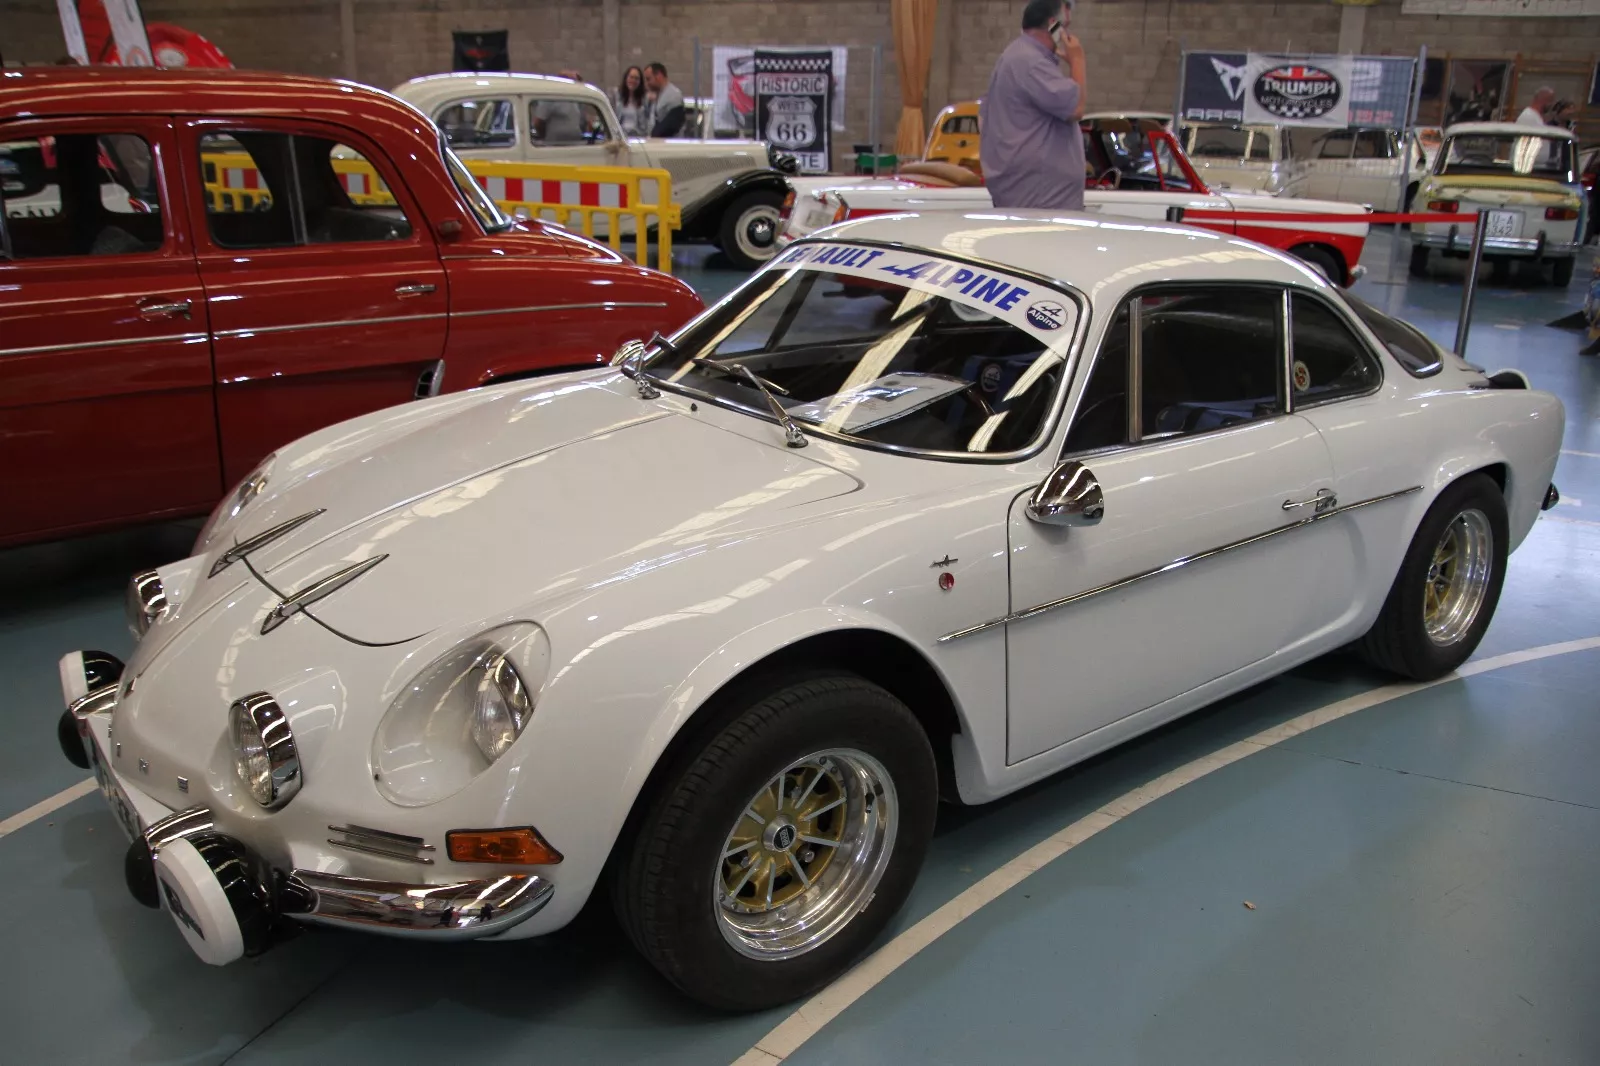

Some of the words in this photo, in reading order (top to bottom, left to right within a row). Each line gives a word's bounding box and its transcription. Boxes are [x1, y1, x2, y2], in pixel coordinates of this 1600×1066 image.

[761, 77, 823, 92] HISTORIC
[1261, 77, 1337, 95] TRIUMPH
[777, 123, 807, 141] 66
[881, 260, 1031, 312] ALPINE
[1027, 308, 1059, 329] Alpine
